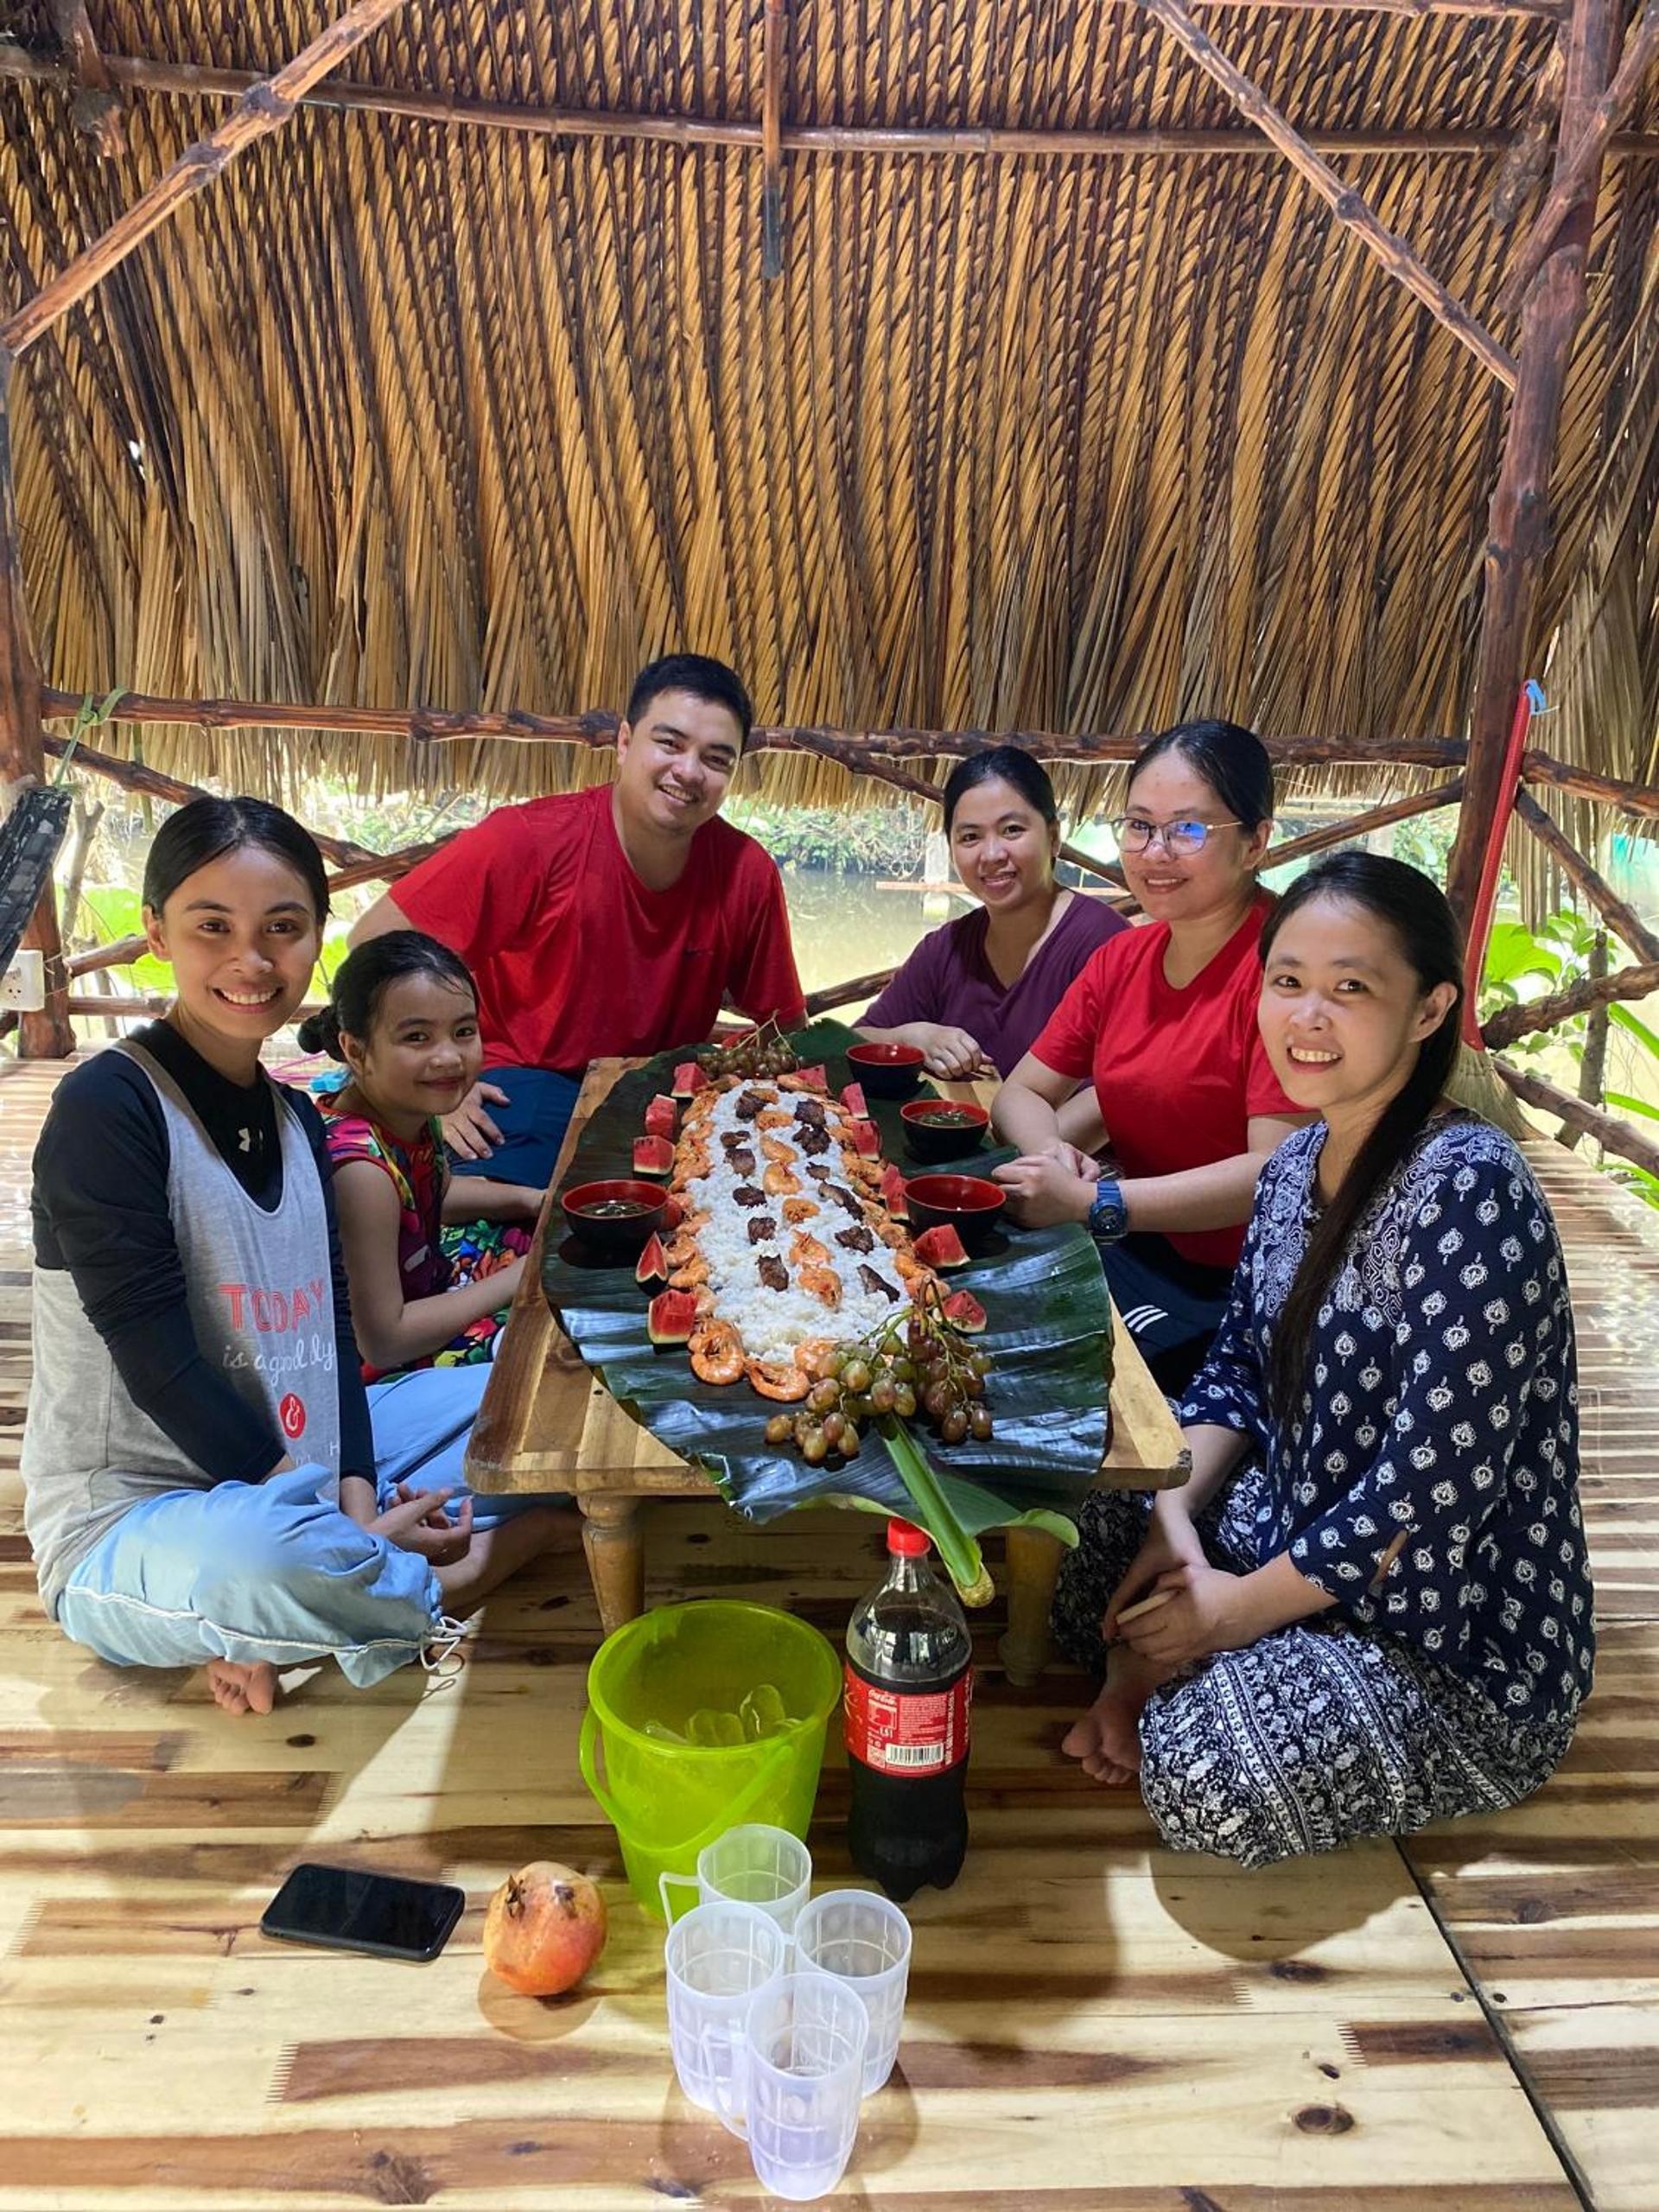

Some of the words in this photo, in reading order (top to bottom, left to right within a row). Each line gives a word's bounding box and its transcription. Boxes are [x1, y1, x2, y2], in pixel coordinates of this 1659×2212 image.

[217, 1278, 323, 1332] TODAY
[222, 1344, 249, 1370] is
[254, 1354, 267, 1370] a
